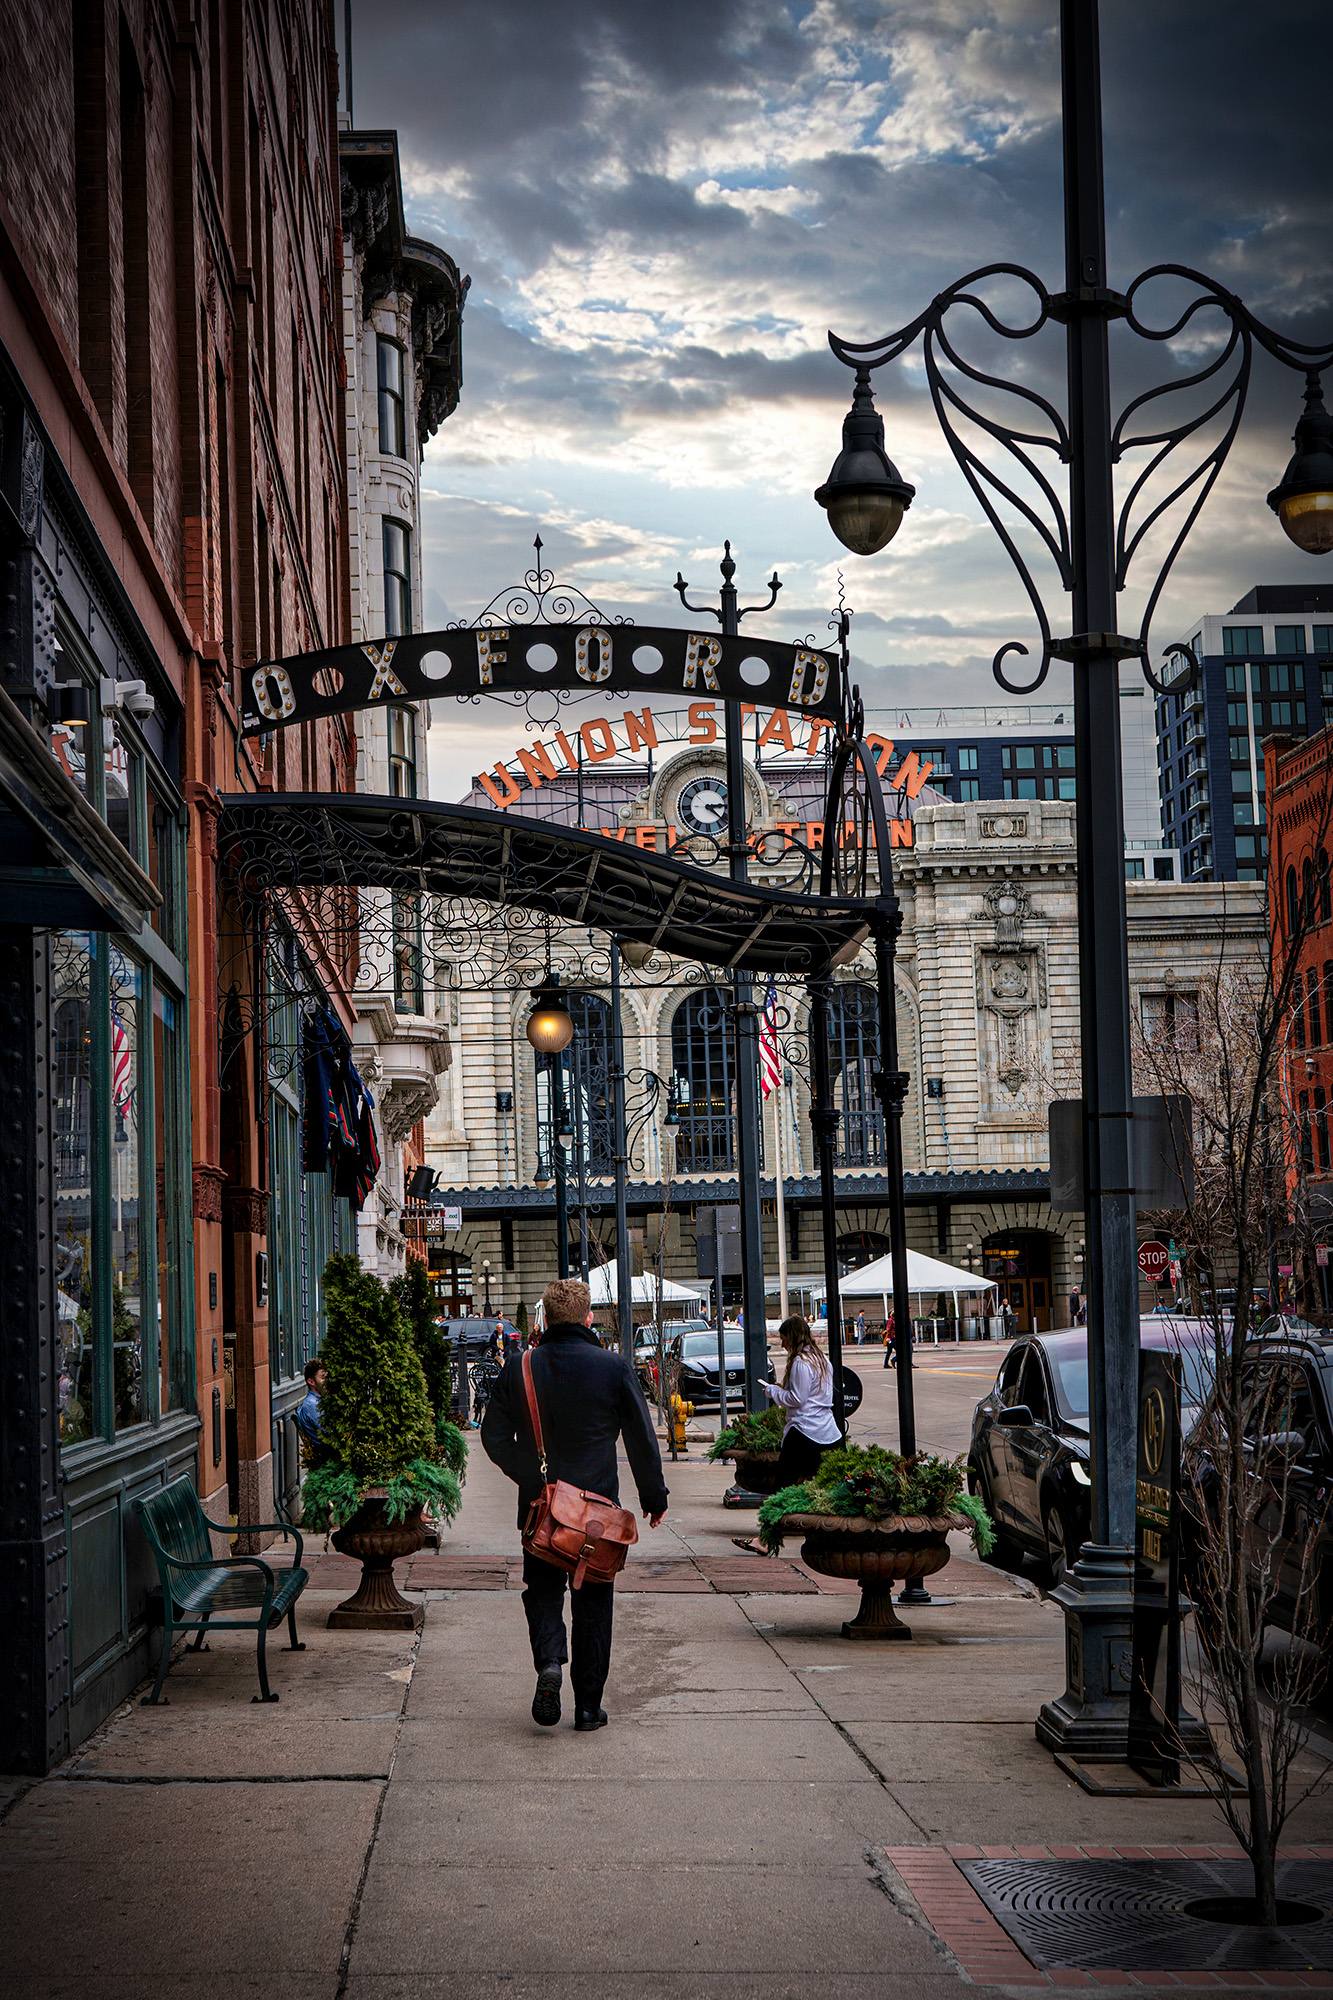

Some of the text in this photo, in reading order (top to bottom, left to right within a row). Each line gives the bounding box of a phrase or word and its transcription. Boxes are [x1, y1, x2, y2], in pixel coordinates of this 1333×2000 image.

[251, 627, 829, 720] OXFORD
[477, 702, 935, 808] UNION SATON
[1139, 1251, 1167, 1266] STOP
